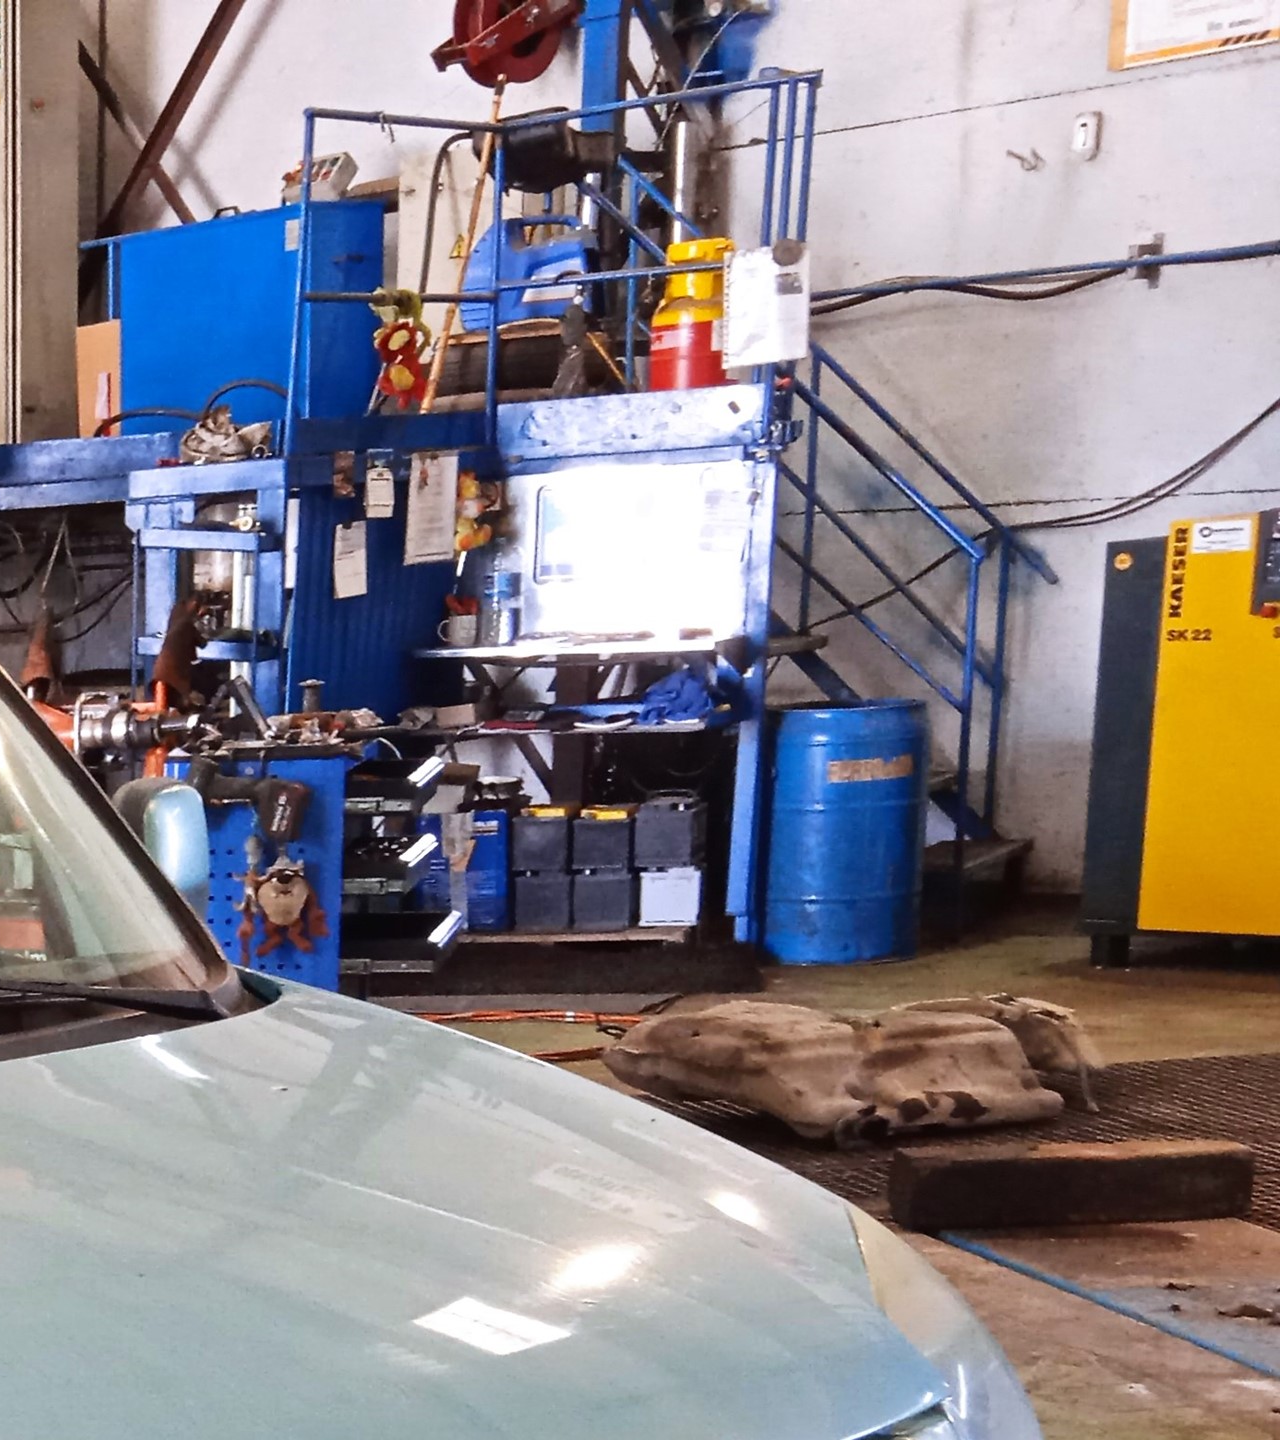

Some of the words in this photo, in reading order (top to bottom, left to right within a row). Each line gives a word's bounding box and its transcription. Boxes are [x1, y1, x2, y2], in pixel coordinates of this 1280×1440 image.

[1168, 527, 1189, 618] KAESER
[1167, 629, 1189, 641] SK
[1191, 629, 1212, 641] 22
